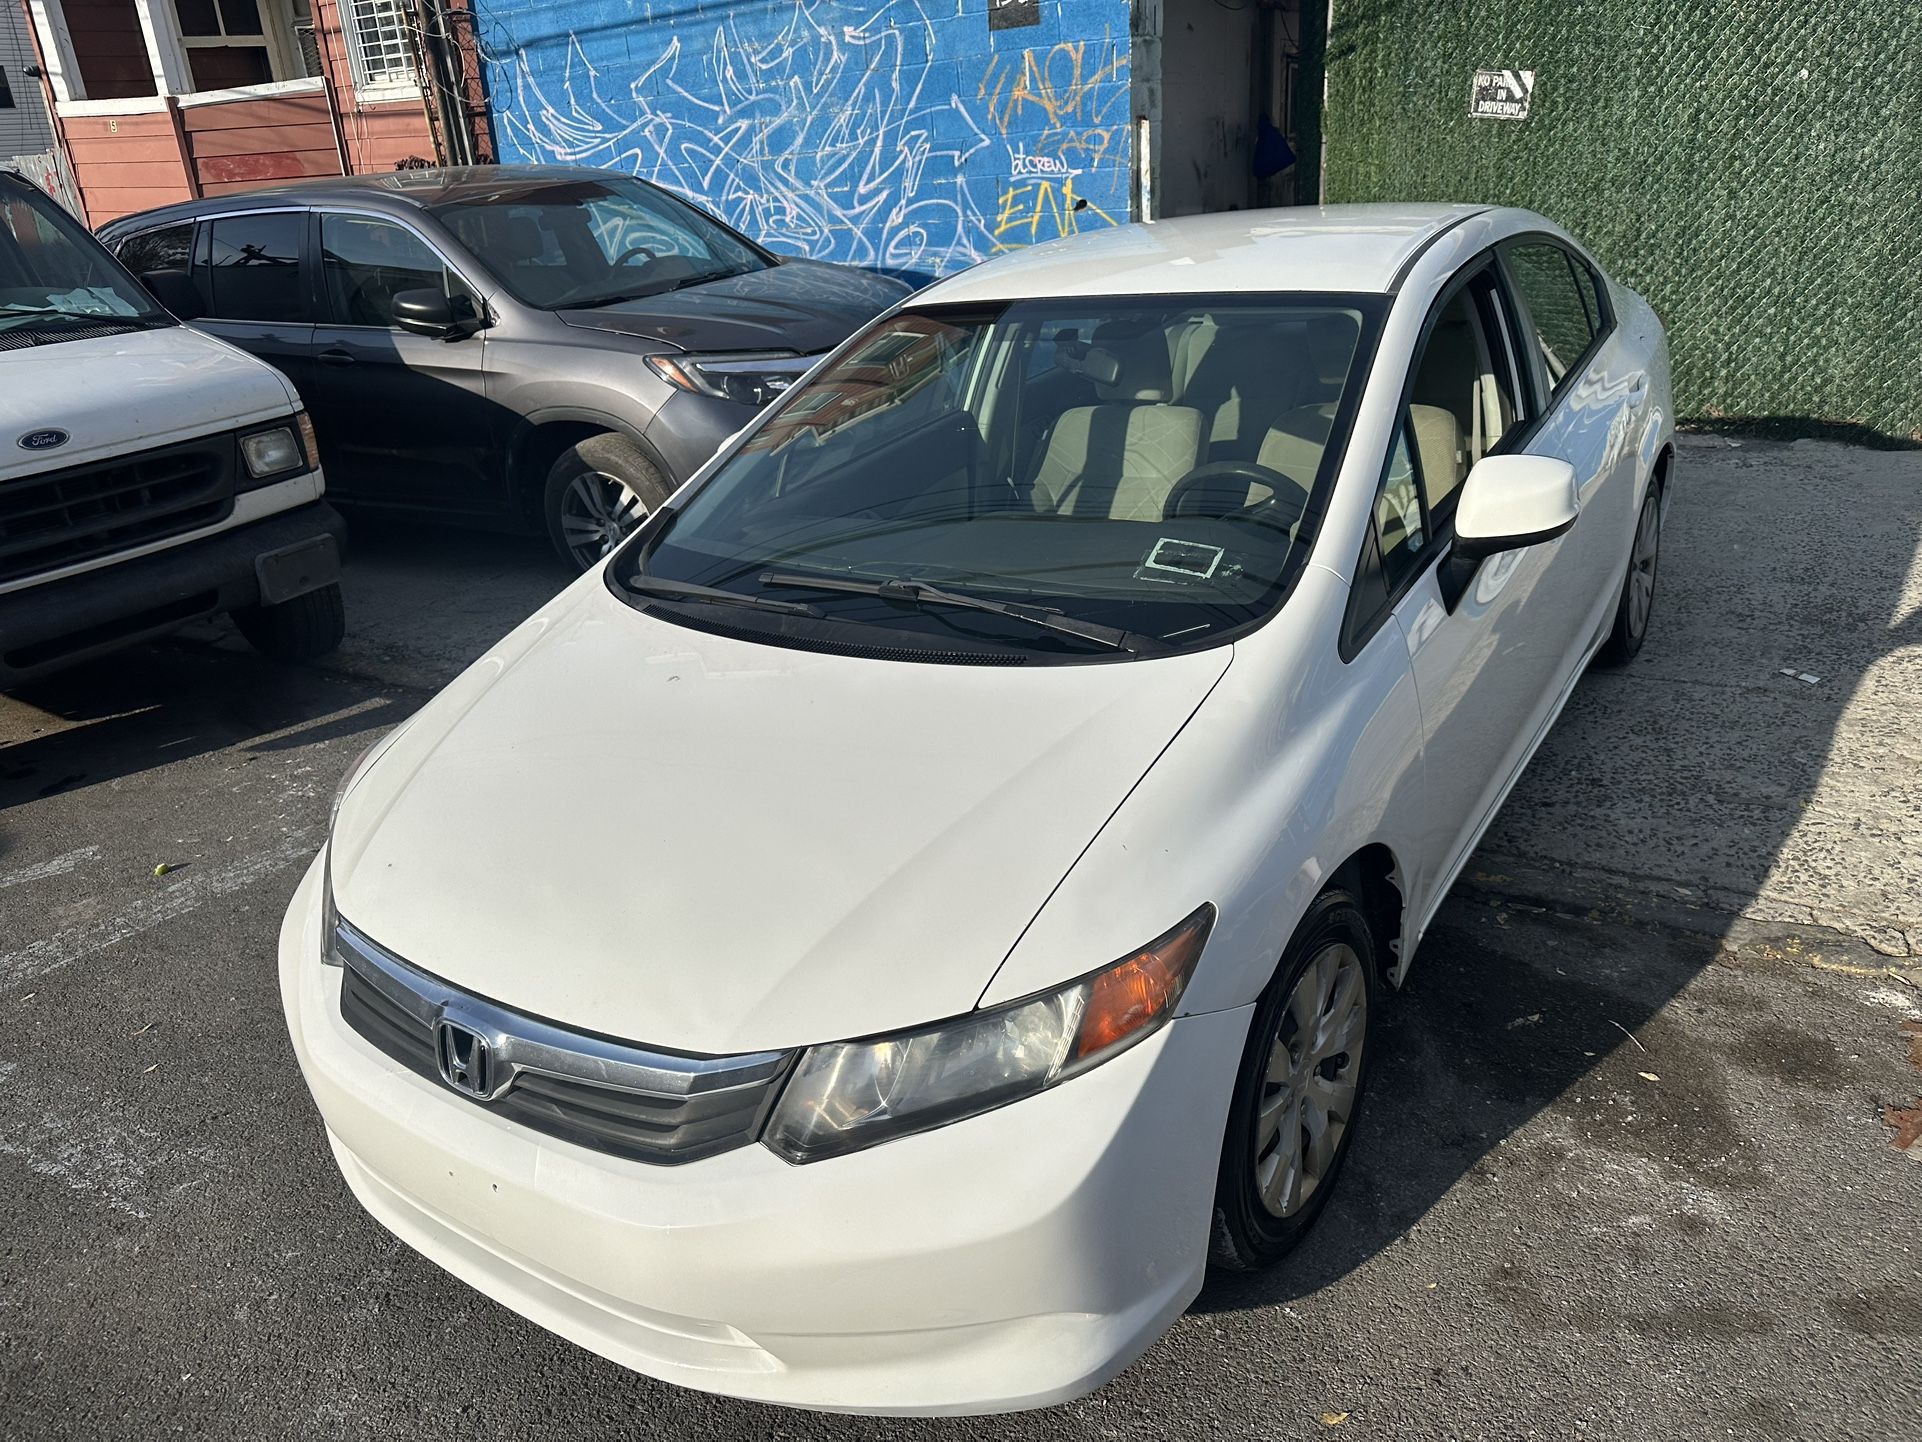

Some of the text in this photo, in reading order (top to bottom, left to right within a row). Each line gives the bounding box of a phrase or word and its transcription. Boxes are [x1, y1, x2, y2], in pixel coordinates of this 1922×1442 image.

[1477, 74, 1491, 88] NO
[1496, 88, 1507, 101] IN
[1477, 100, 1522, 116] DRIVEWAY
[32, 433, 57, 446] Ford
